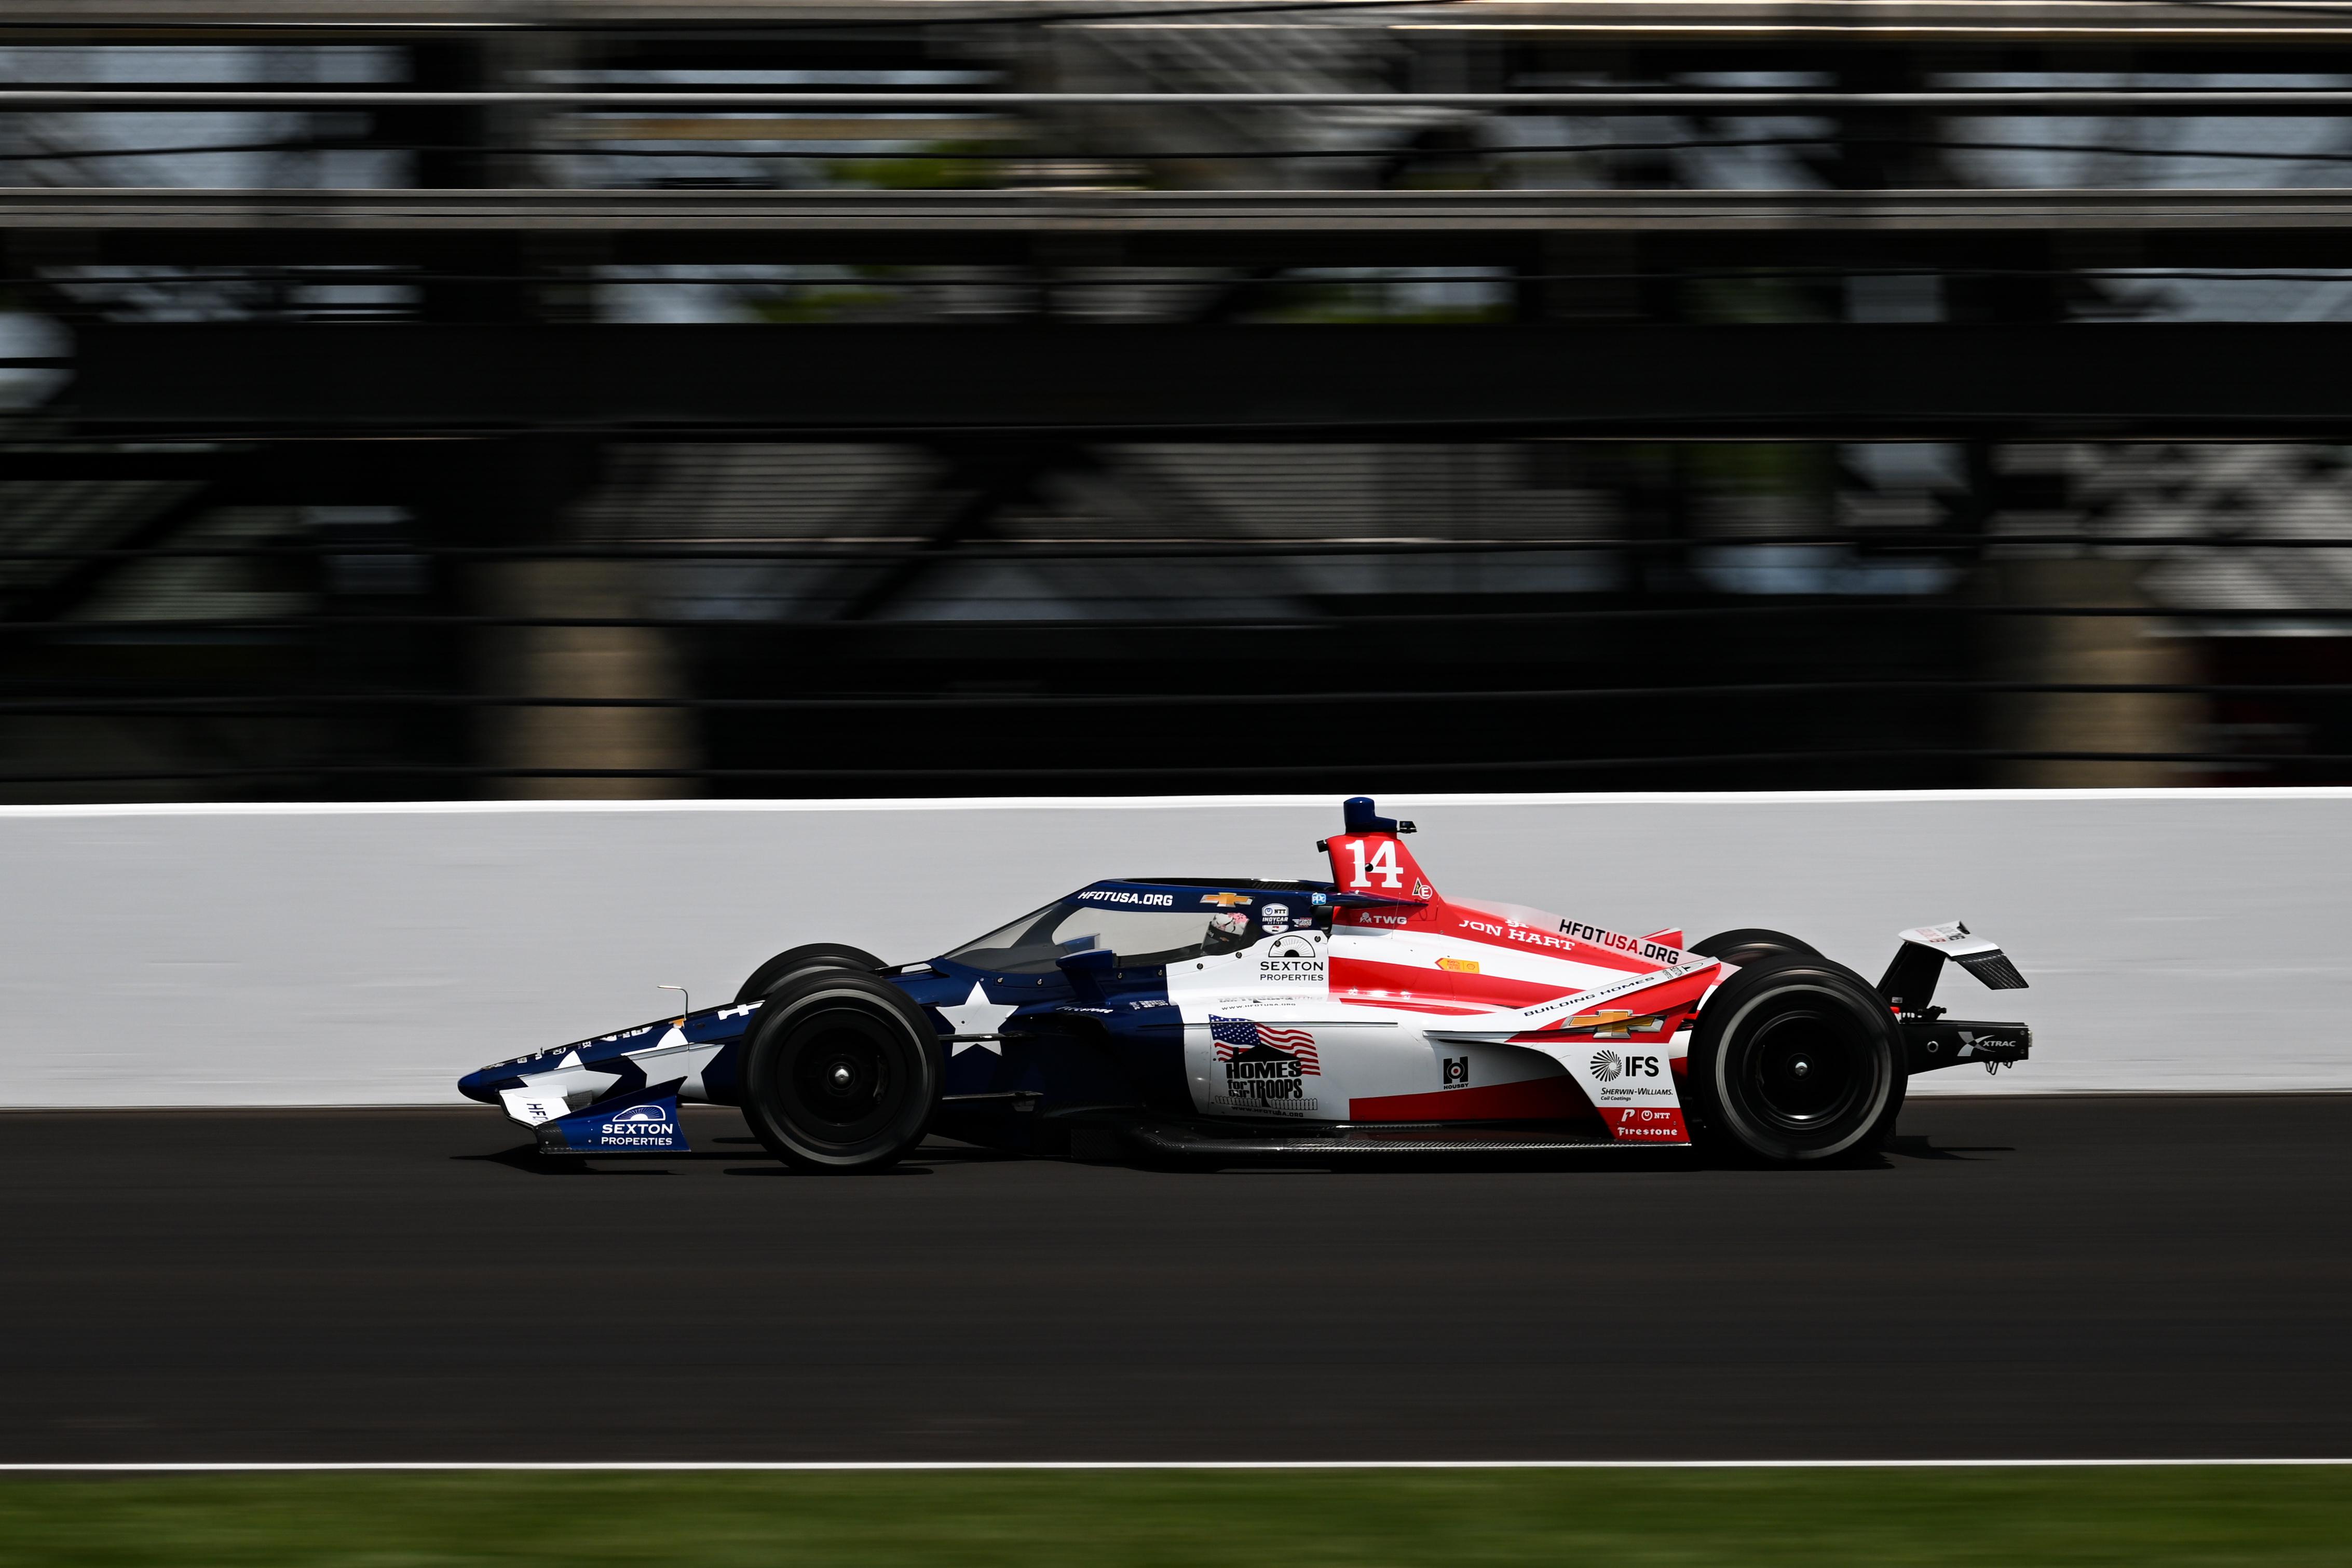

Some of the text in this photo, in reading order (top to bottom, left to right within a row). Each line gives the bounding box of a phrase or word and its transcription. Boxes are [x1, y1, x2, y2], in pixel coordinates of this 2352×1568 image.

[1345, 840, 1404, 888] 14
[1077, 891, 1173, 906] HFOTUSA.ORG
[1421, 887, 1430, 897] E
[1373, 916, 1407, 924] TWG
[1459, 920, 1503, 936] JON
[1508, 929, 1575, 950] HART
[1559, 919, 1679, 964] HFOTUSA.ORG
[1260, 961, 1324, 971] SEXTON
[1524, 976, 1655, 1017] BUILDING HOMES
[1226, 1060, 1302, 1079] HOMES
[1626, 1056, 1659, 1077] IFS
[1227, 1078, 1303, 1099] for TROOPS
[602, 1124, 673, 1135] SEXTON
[1617, 1127, 1678, 1136] Firestone
[601, 1137, 673, 1146] PROPERTIES
